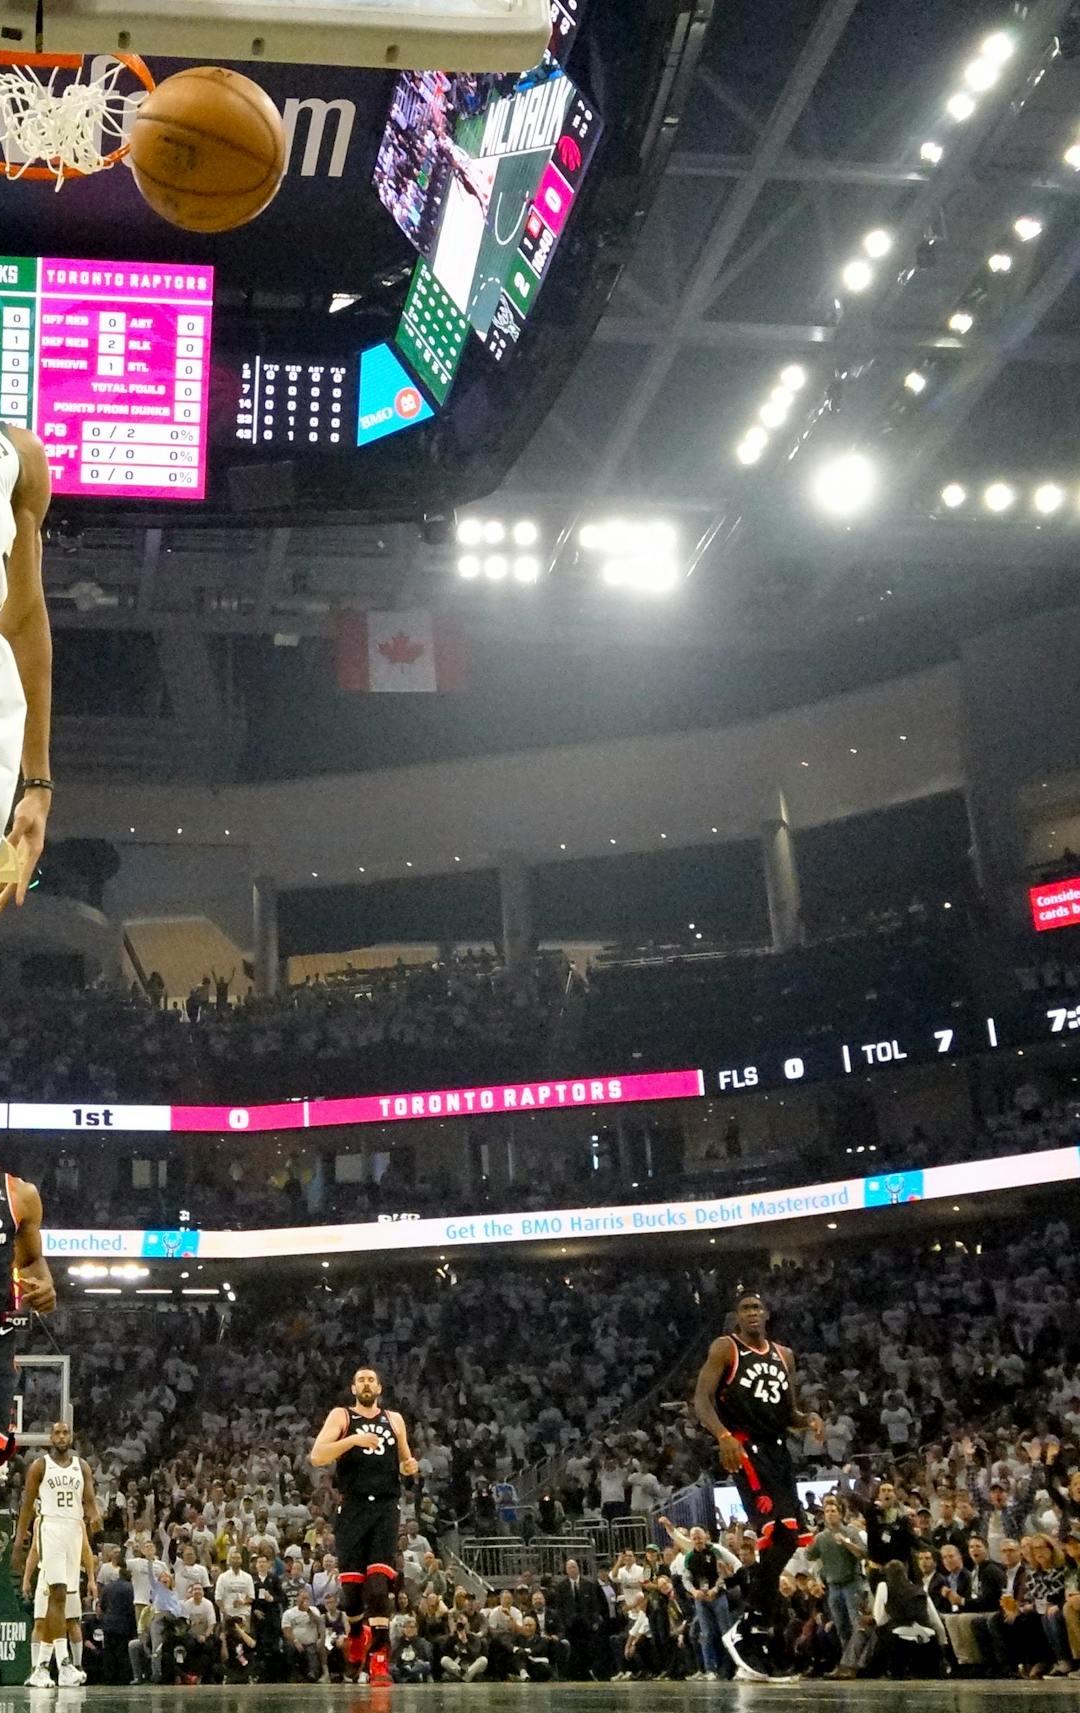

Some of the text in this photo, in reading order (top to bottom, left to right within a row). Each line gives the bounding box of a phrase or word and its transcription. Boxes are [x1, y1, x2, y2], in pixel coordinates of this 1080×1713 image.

[544, 187, 562, 216] 0
[533, 230, 554, 273] 10:40
[46, 269, 207, 291] TORONTO RAPTORS
[512, 271, 530, 297] 2
[108, 319, 116, 327] 0
[187, 322, 194, 331] 0
[108, 340, 116, 348] 2
[128, 340, 151, 350] BLK
[186, 344, 194, 352] 0
[185, 366, 192, 374] 0
[266, 371, 275, 380] 0
[289, 372, 298, 381] 0
[312, 372, 320, 382] 0
[333, 373, 342, 383] 0
[91, 382, 192, 396] TOTAL FOULS 0
[242, 384, 250, 394] 7
[53, 401, 191, 418] POINTS FROM DUNKS 0
[238, 398, 252, 409] 14
[264, 415, 273, 425] 0
[310, 417, 319, 427] 0
[331, 418, 340, 428] 0
[360, 407, 393, 430] BMO
[44, 423, 67, 437] FG
[92, 428, 100, 436] 0
[127, 429, 135, 438] 2
[170, 430, 194, 441] 0%
[263, 430, 272, 440] 0
[309, 432, 318, 442] 0
[330, 433, 339, 442] 0
[44, 444, 78, 459] 3PT
[91, 448, 100, 457] 0
[126, 450, 134, 459] 0
[170, 451, 192, 462] 0%
[90, 470, 99, 478] 0
[125, 471, 134, 480] 0
[169, 472, 192, 484] 0%
[1037, 889, 1080, 907] Conside
[719, 1066, 758, 1090] FLS
[784, 1058, 804, 1080] 0
[862, 1040, 908, 1065] TOL
[934, 1029, 954, 1053] 7
[71, 1108, 114, 1127] 1st
[229, 1108, 249, 1129] 0
[379, 1090, 494, 1118] TORONTO
[503, 1080, 622, 1108] RAPTORS
[446, 1186, 850, 1240] Get the BMO Harris Bucks Debit Mastercard
[46, 1232, 128, 1251] benched.
[740, 1362, 789, 1390] RAPTORS
[754, 1380, 781, 1404] 43
[355, 1424, 396, 1446] APTORS
[47, 1475, 80, 1490] BUCKS
[57, 1491, 73, 1507] 22
